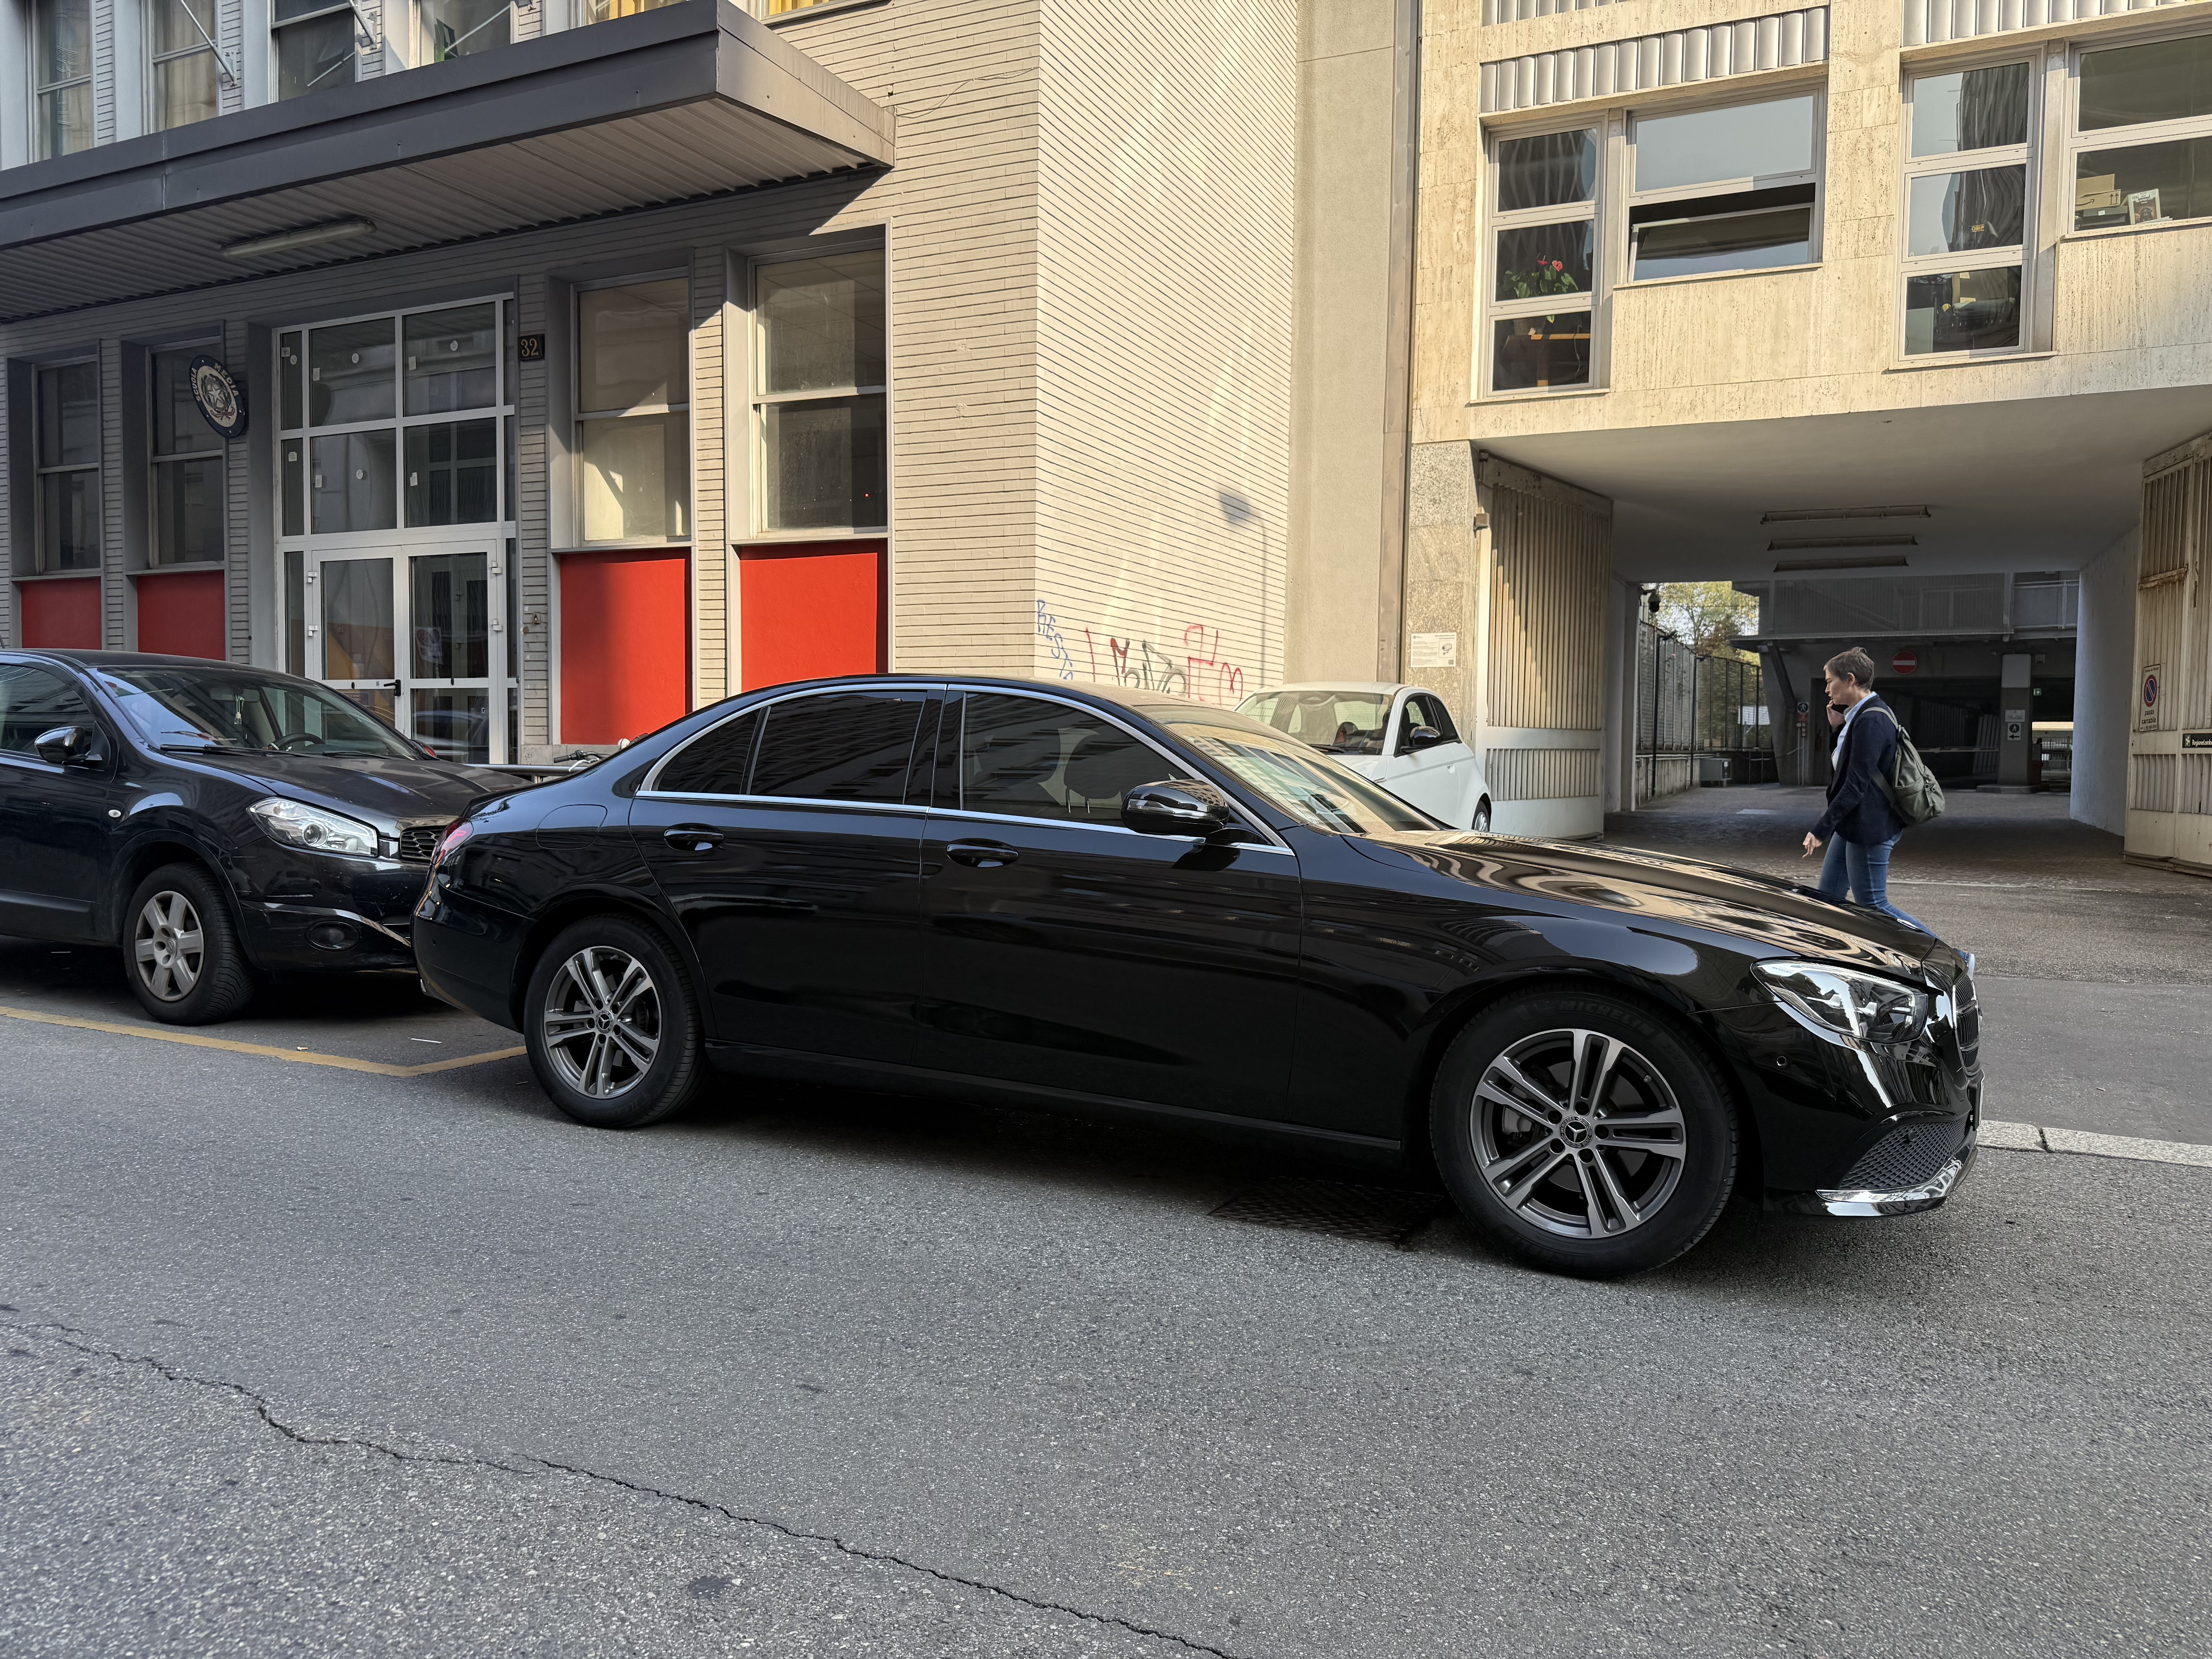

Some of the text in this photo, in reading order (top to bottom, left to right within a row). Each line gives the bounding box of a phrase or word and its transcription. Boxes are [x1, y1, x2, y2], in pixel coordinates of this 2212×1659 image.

[520, 338, 539, 357] 32
[191, 362, 240, 402] SCUOLA MEDIA
[1558, 1000, 1656, 1036] MICHELIN
[1560, 1116, 1591, 1146] MERCEDES BENZ
